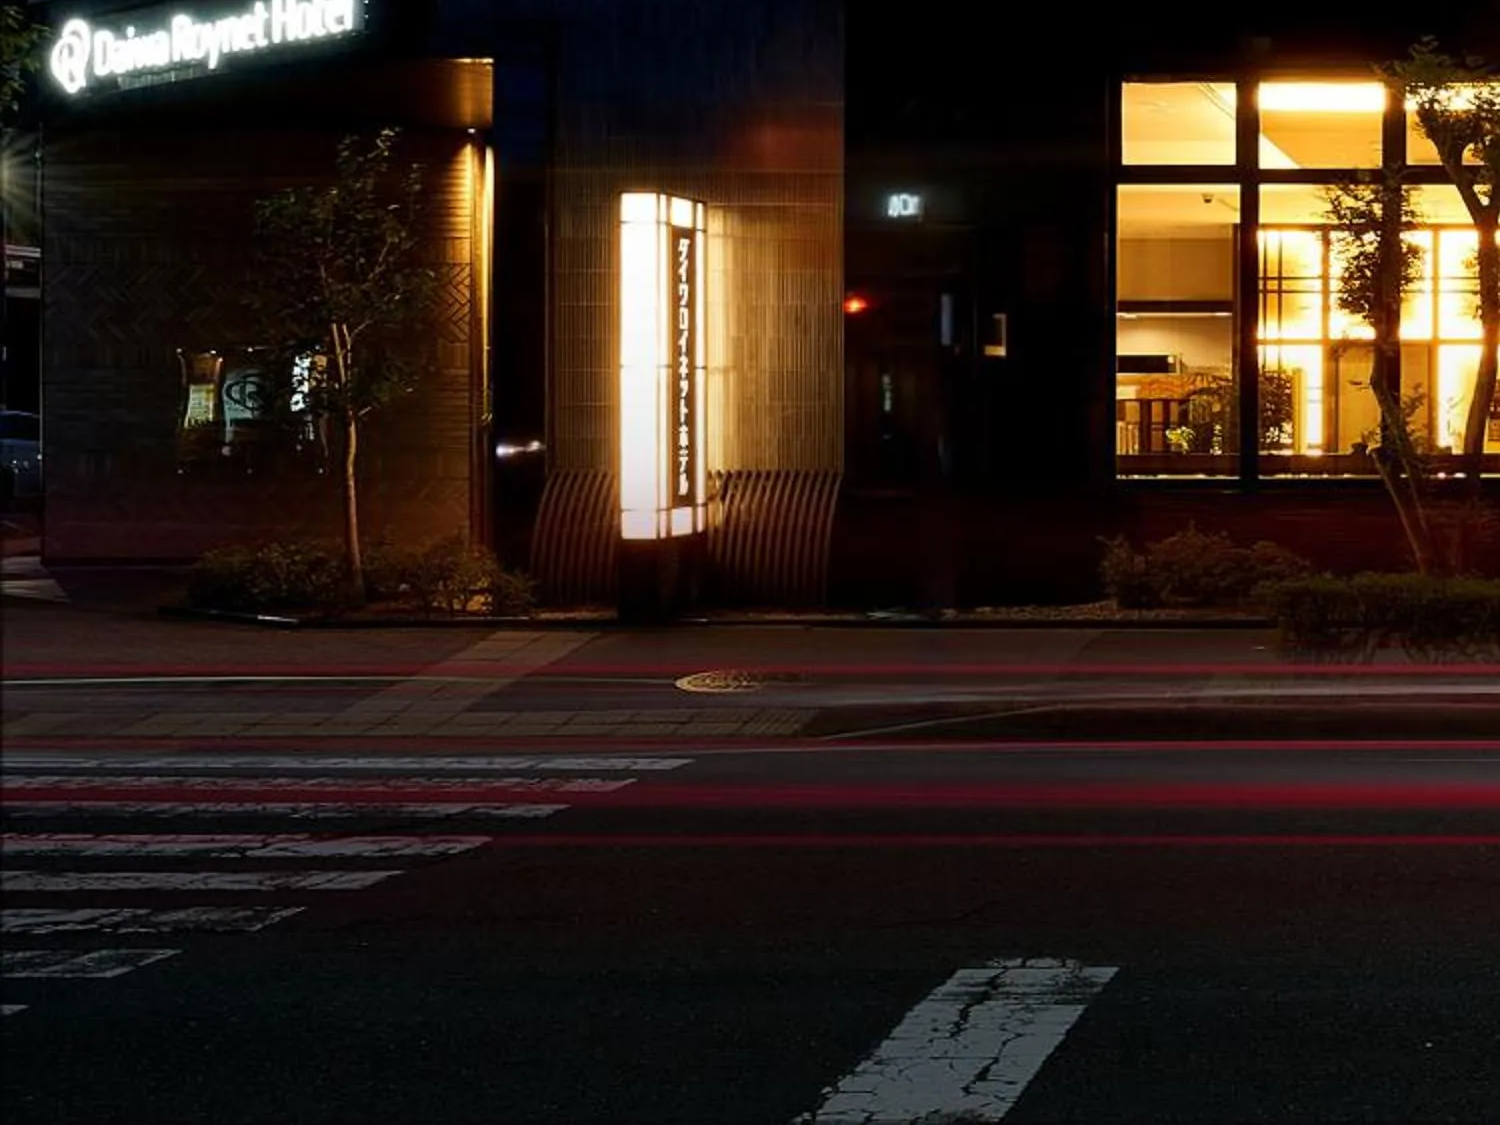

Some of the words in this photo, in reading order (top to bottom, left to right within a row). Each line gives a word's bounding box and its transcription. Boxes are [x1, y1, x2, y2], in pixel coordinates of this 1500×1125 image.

[93, 26, 171, 76] Daiwa
[171, 0, 269, 70] Roynet
[677, 237, 691, 496] ダイワロイネットホテル
